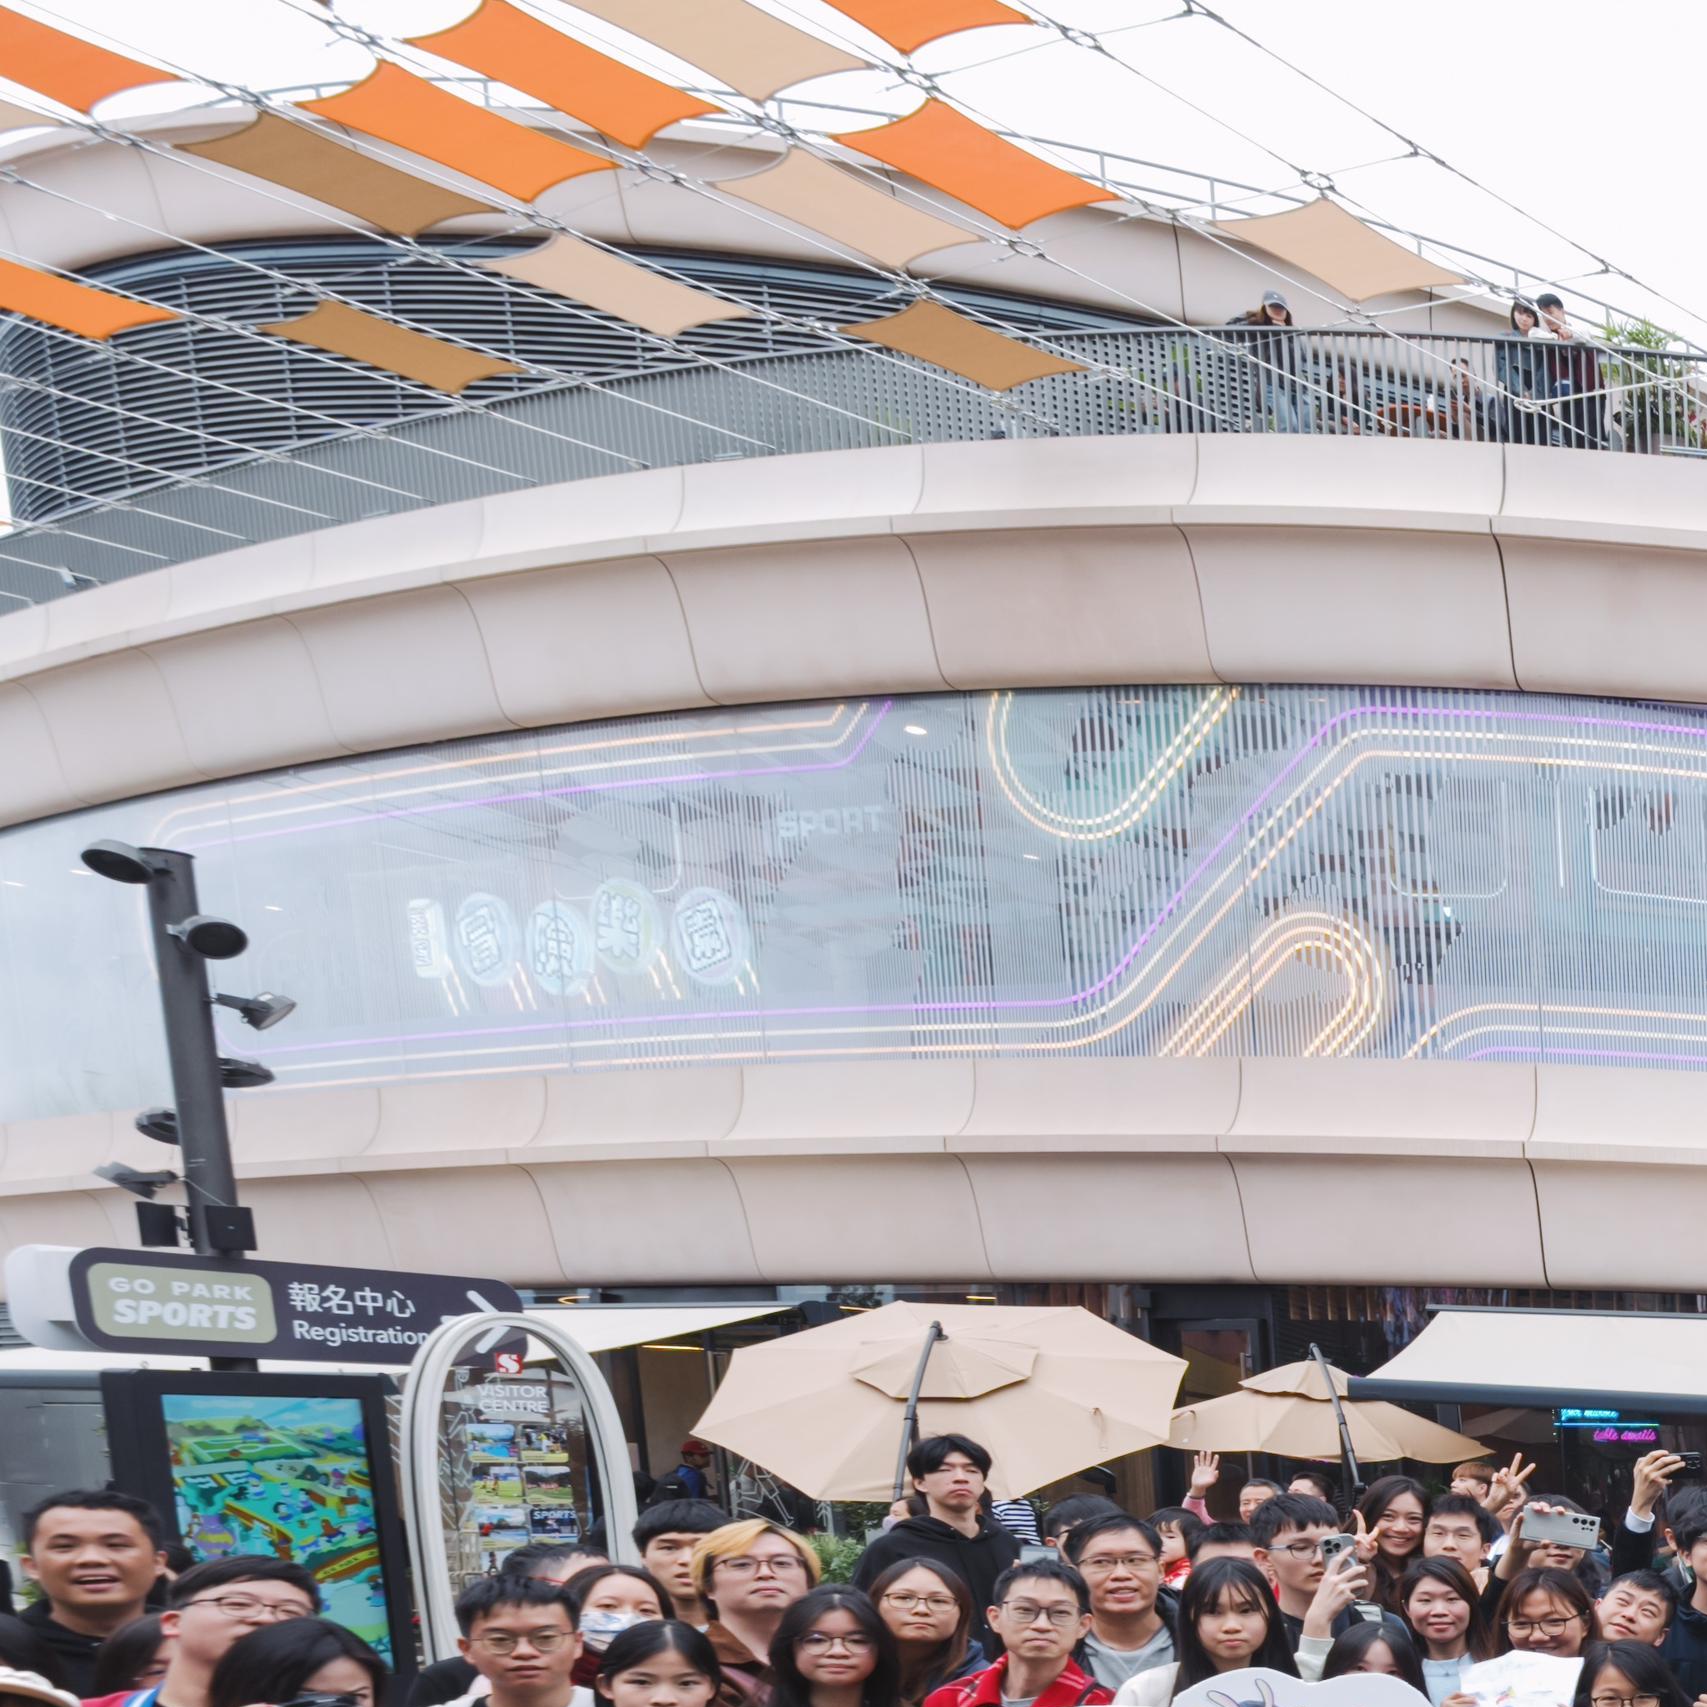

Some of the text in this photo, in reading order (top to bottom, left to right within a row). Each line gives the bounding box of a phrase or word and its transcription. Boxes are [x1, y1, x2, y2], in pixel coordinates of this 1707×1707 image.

[109, 1277, 252, 1301] GO PARK
[288, 1281, 416, 1319] 報名中心
[113, 1299, 257, 1331] SPORTS
[292, 1320, 430, 1347] Registration
[477, 1385, 548, 1398] VISITOR
[479, 1400, 549, 1412] CENTRE
[533, 1510, 577, 1519] SPORTS
